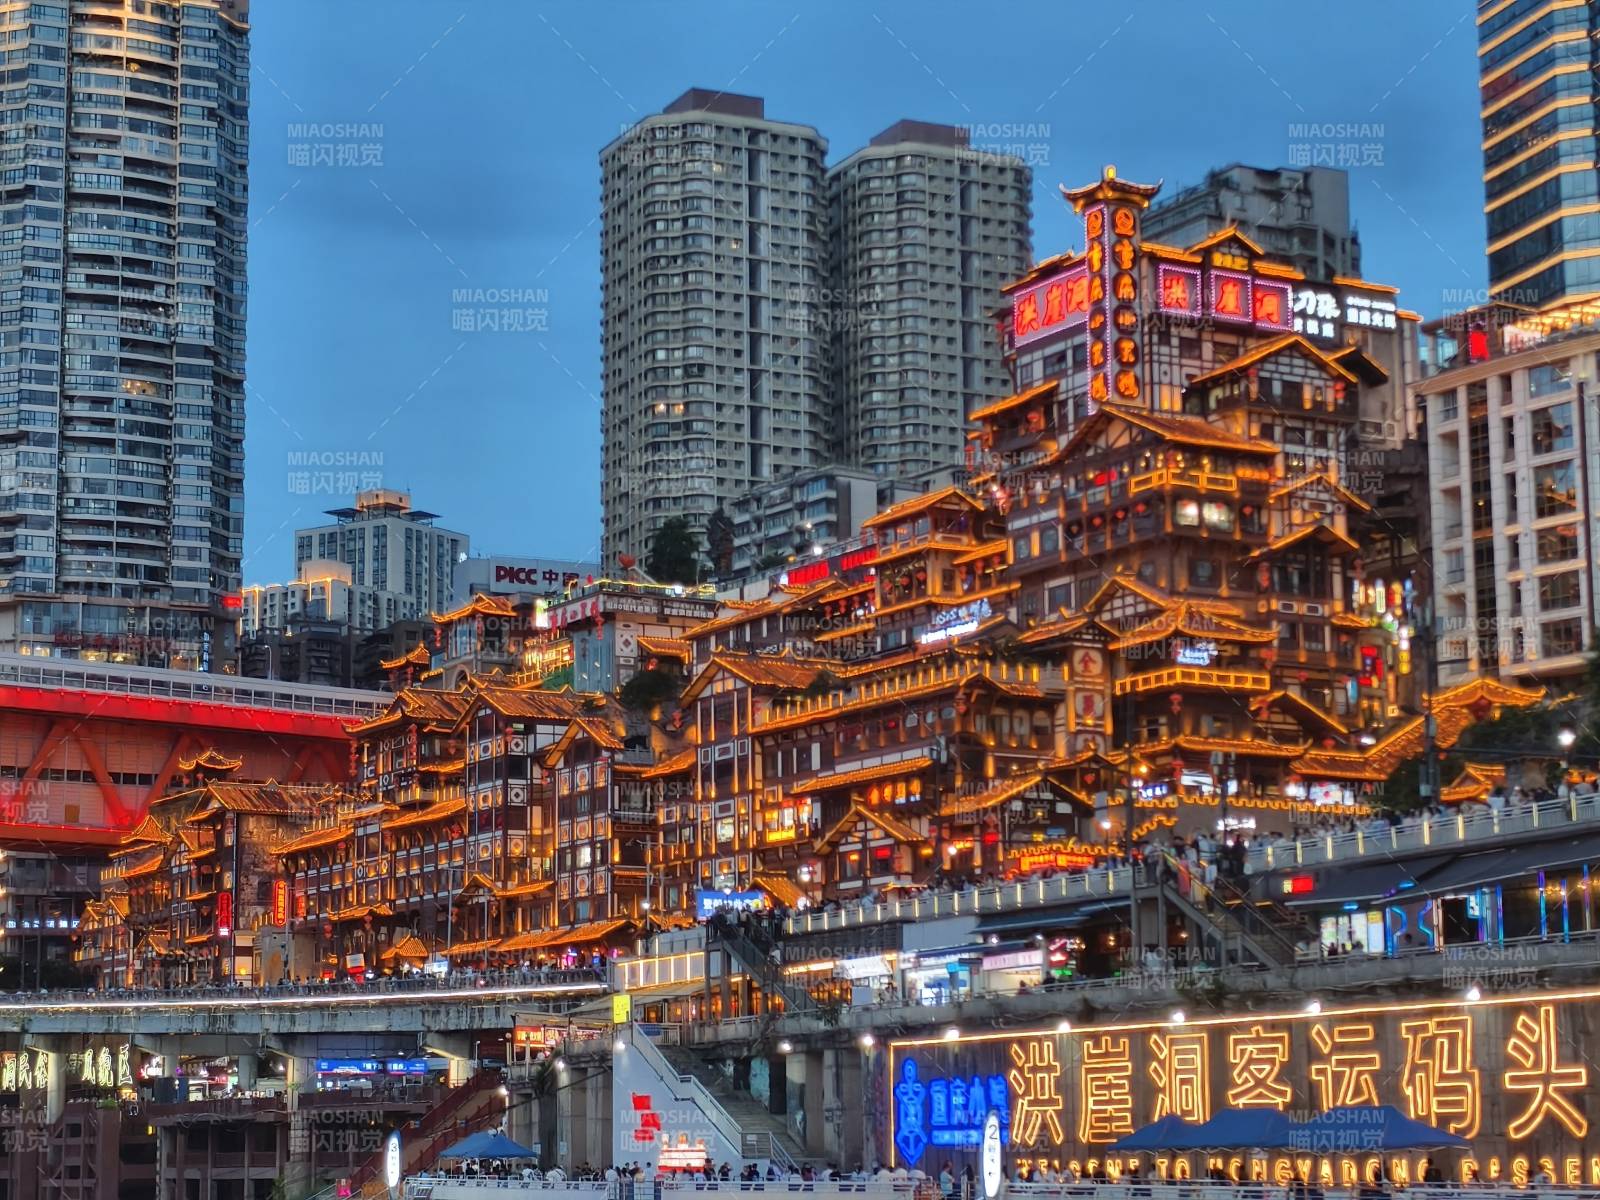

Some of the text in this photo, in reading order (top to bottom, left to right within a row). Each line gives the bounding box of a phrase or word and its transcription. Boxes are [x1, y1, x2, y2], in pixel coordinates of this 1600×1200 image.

[1016, 276, 1090, 336] 洪崖洞
[1163, 275, 1281, 324] 洪崖洞
[495, 565, 538, 585] PICC
[1009, 1006, 1588, 1145] 洪崖洞客运码头
[988, 1124, 998, 1140] 2
[391, 1142, 398, 1153] 3
[1157, 1158, 1190, 1185] TO
